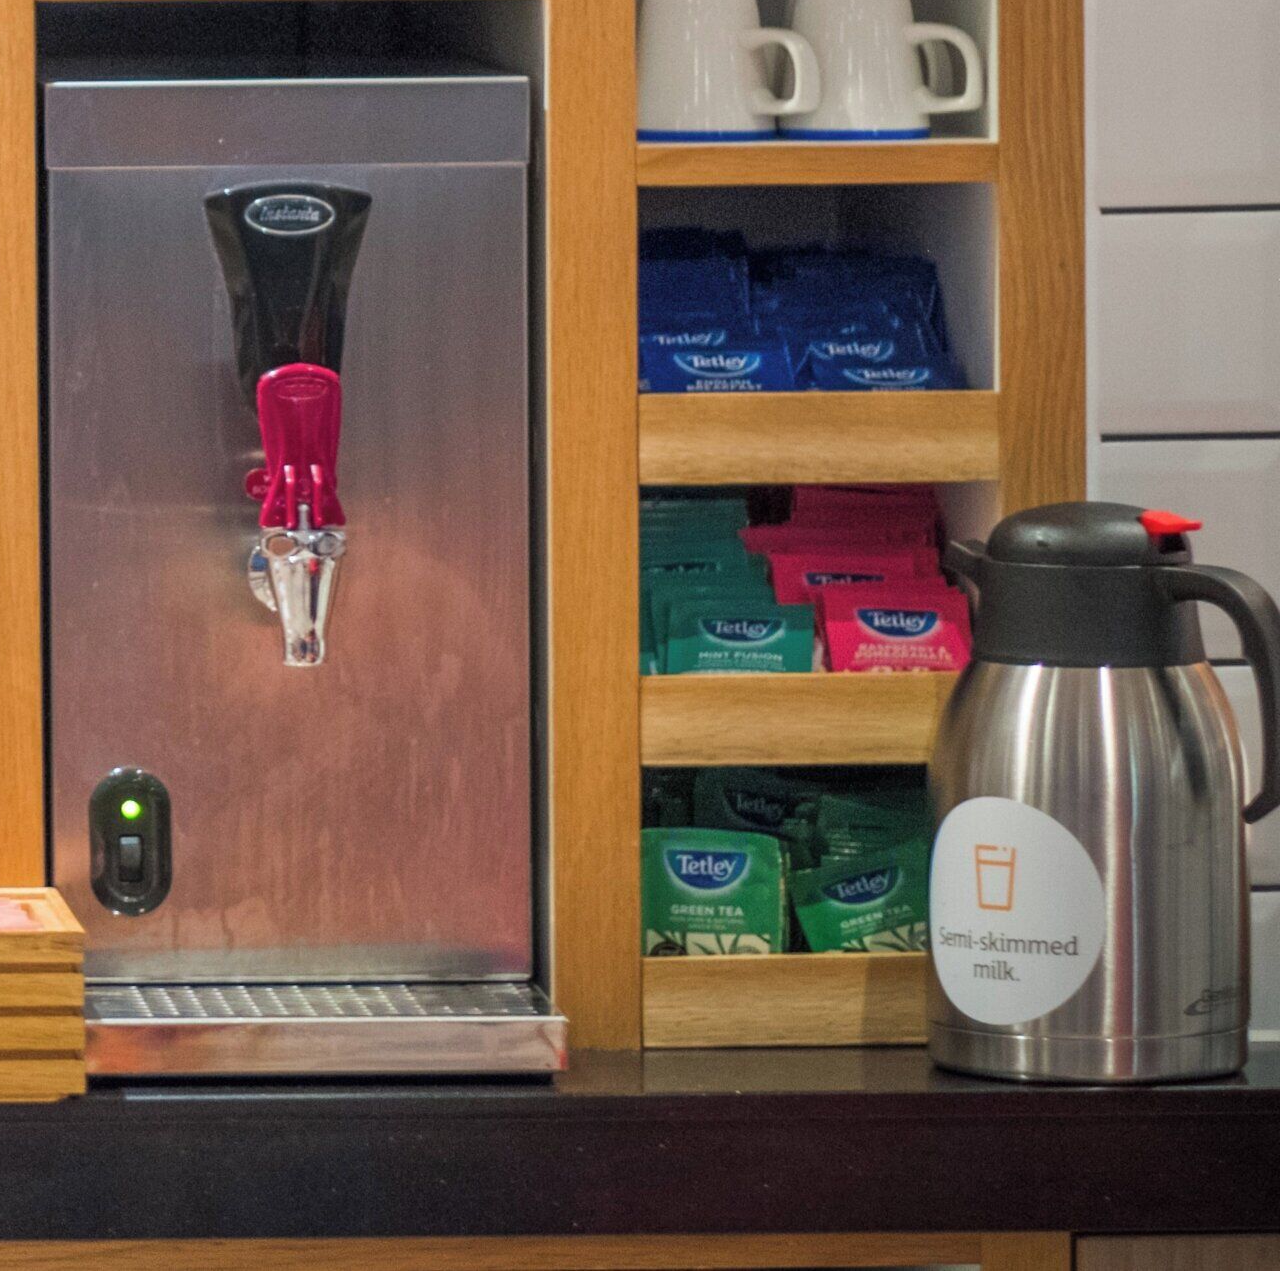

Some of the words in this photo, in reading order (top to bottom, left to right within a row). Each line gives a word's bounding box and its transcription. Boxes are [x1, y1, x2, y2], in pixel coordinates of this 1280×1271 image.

[687, 354, 748, 370] Tetley
[711, 618, 774, 638] Tetley
[868, 609, 928, 632] Tetley
[676, 853, 740, 882] Tetley
[831, 871, 890, 899] Tetley
[670, 903, 715, 916] GREEN
[718, 905, 744, 917] TEA
[939, 927, 1079, 956] Semi-skimmed
[973, 960, 1020, 982] milk.
